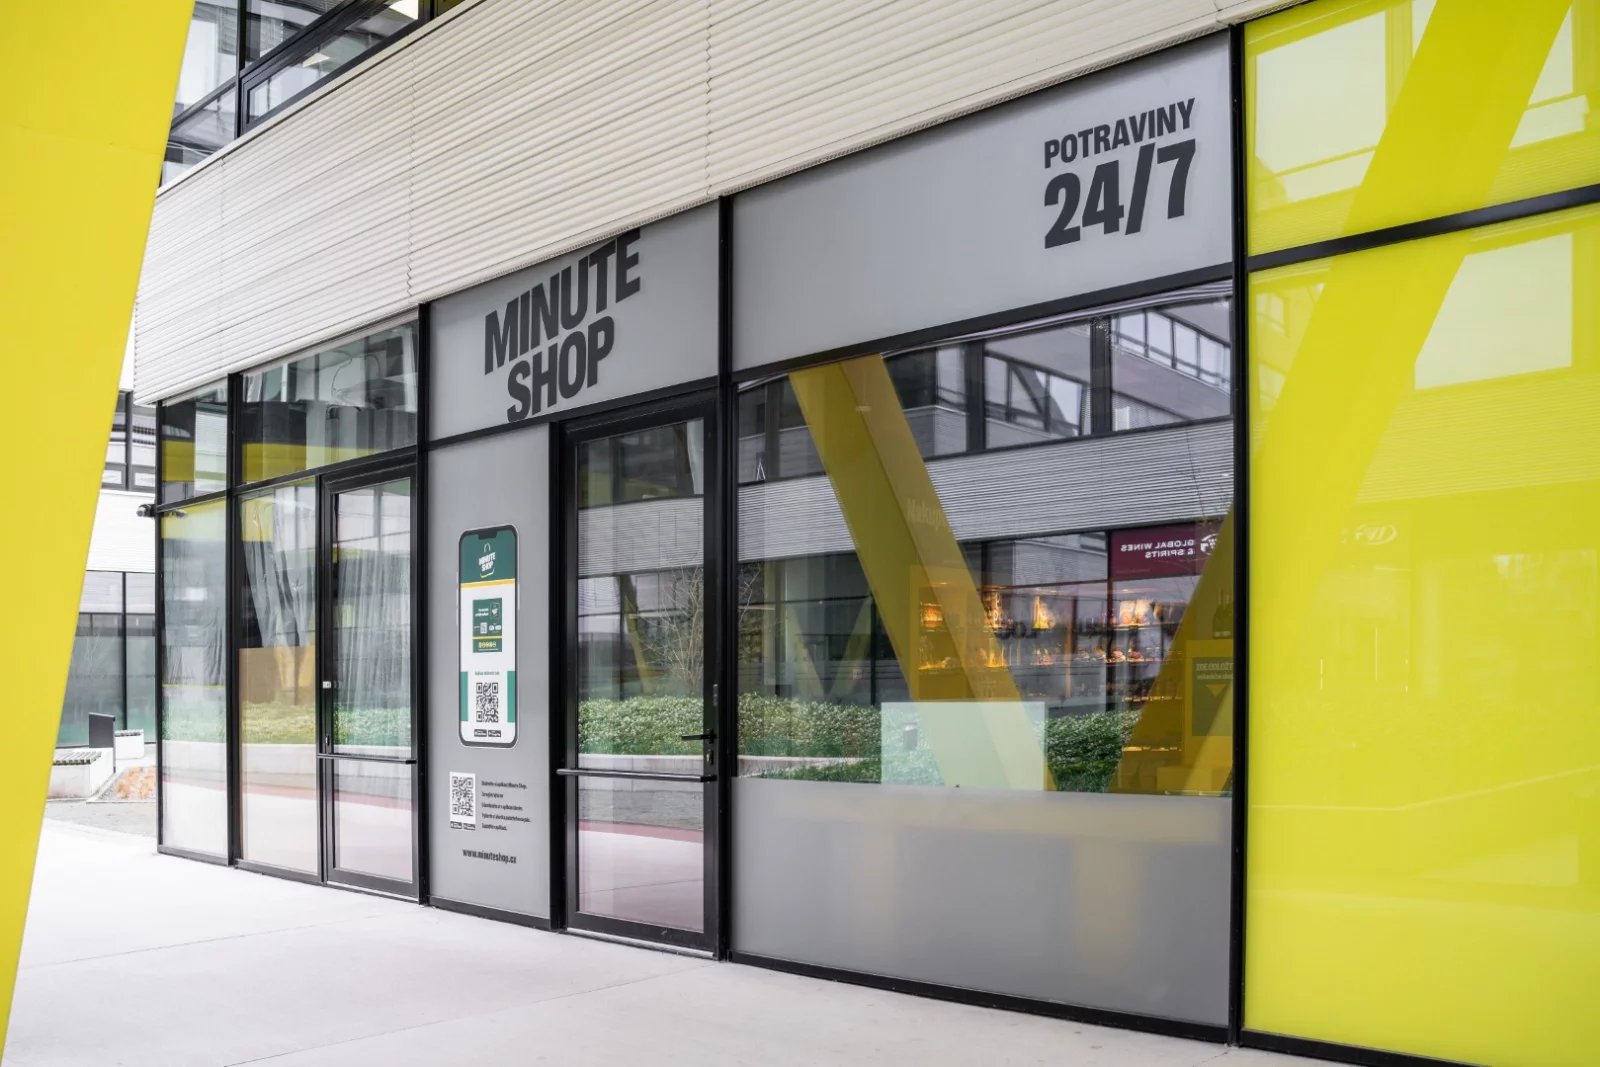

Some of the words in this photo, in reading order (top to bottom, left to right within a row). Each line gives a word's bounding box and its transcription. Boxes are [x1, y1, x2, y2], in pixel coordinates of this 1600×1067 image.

[1044, 97, 1196, 169] POTRAVINY
[1044, 138, 1196, 249] 24/7
[484, 227, 641, 376] MINUTE
[506, 315, 615, 423] SHOP
[462, 849, 517, 864] www.minuteshop.cz
